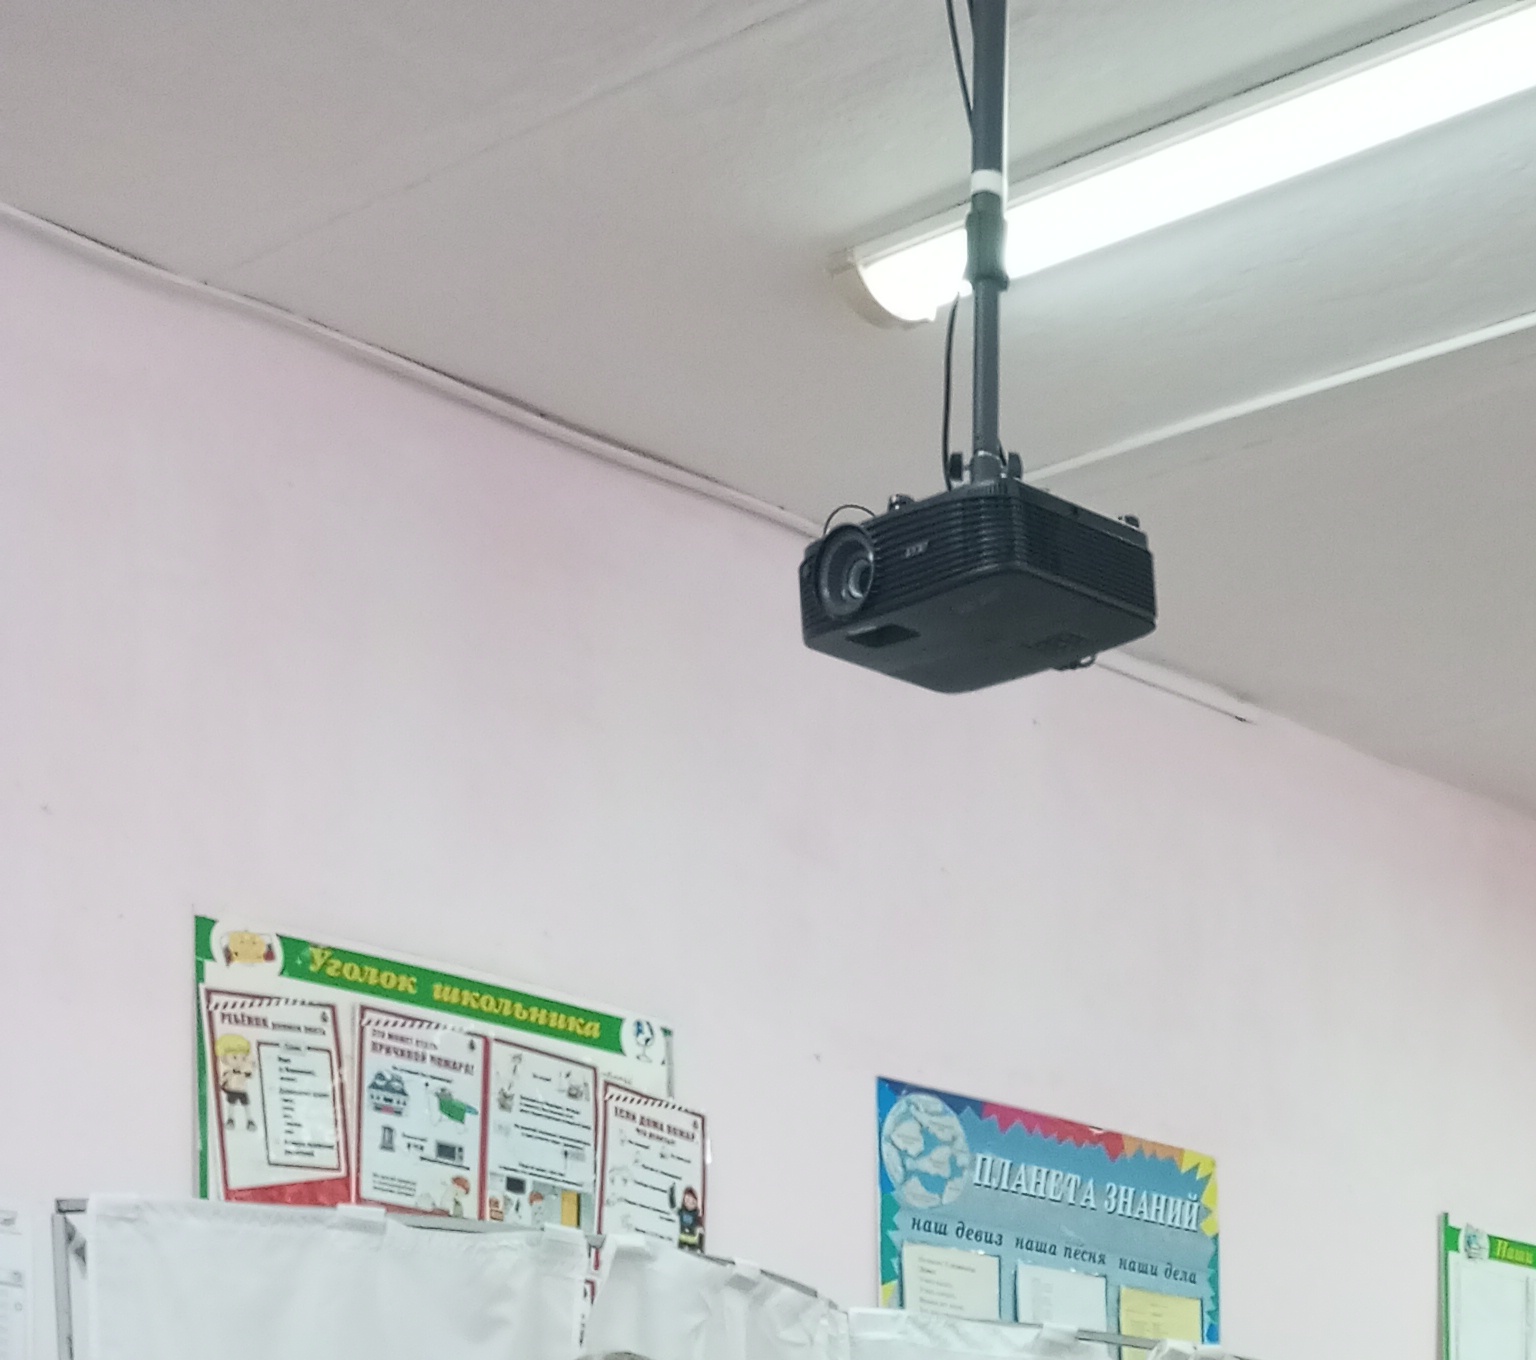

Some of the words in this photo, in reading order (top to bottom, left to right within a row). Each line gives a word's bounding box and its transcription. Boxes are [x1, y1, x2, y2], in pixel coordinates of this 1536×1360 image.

[309, 946, 417, 994] Уголок
[433, 983, 600, 1038] школьника
[973, 1153, 1097, 1210] ПЛАНЕТА
[1104, 1182, 1200, 1232] ЗНАНИЙ
[911, 1217, 948, 1236] наш
[955, 1220, 1004, 1246] девиз
[1014, 1237, 1058, 1256] наша
[1063, 1244, 1106, 1265] песня
[1119, 1257, 1158, 1277] наши
[1164, 1262, 1197, 1285] дела
